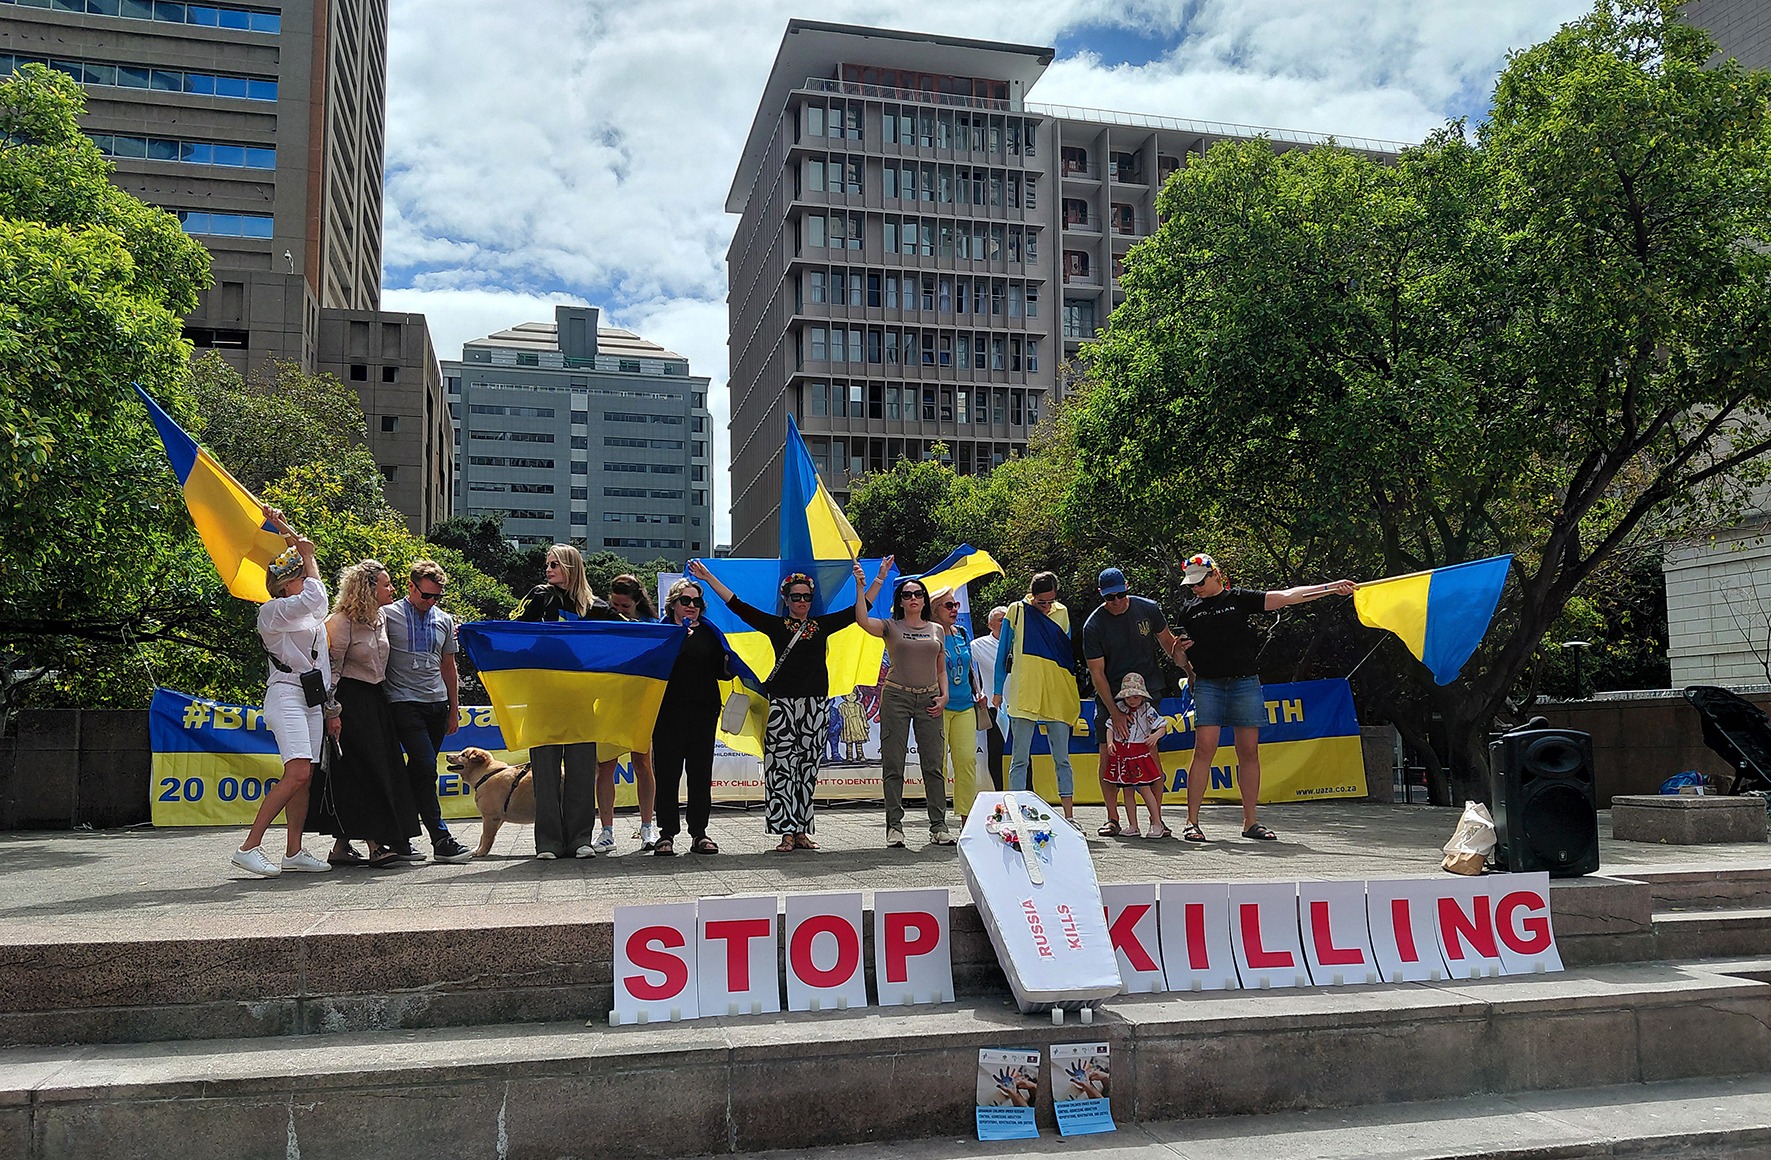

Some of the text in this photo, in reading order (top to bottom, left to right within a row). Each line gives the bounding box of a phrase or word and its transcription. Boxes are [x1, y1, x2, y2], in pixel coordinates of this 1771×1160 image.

[183, 700, 275, 730] #Br
[158, 777, 205, 802] 20
[1296, 785, 1357, 796] www.uaza.co.za
[623, 890, 1553, 1001] STOP KILLING
[1021, 898, 1053, 957] RUSSIA
[1056, 904, 1082, 950] KILLS
